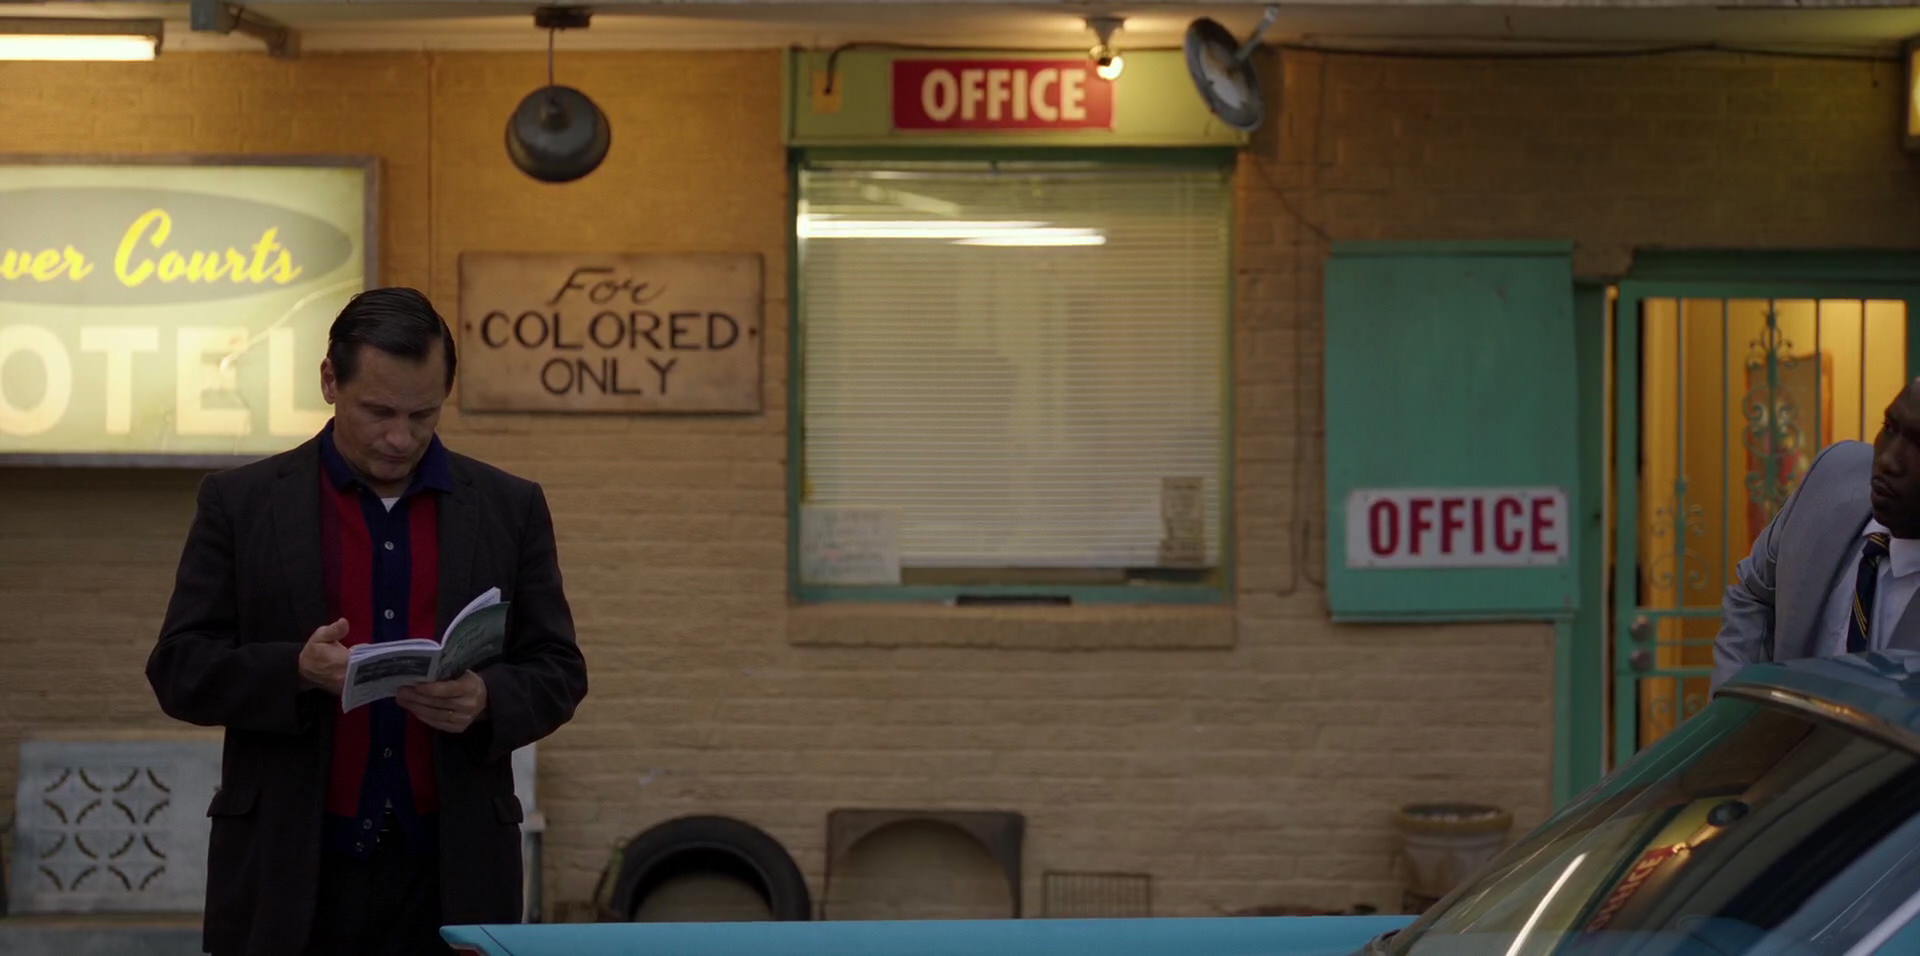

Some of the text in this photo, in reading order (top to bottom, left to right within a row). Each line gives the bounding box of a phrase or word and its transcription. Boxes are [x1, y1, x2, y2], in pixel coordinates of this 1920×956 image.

[921, 68, 1087, 122] OFFICE
[114, 208, 303, 287] Courts
[547, 267, 666, 306] For
[480, 310, 740, 350] COLORED
[540, 357, 677, 396] ONLY
[1368, 496, 1558, 557] OFFICE
